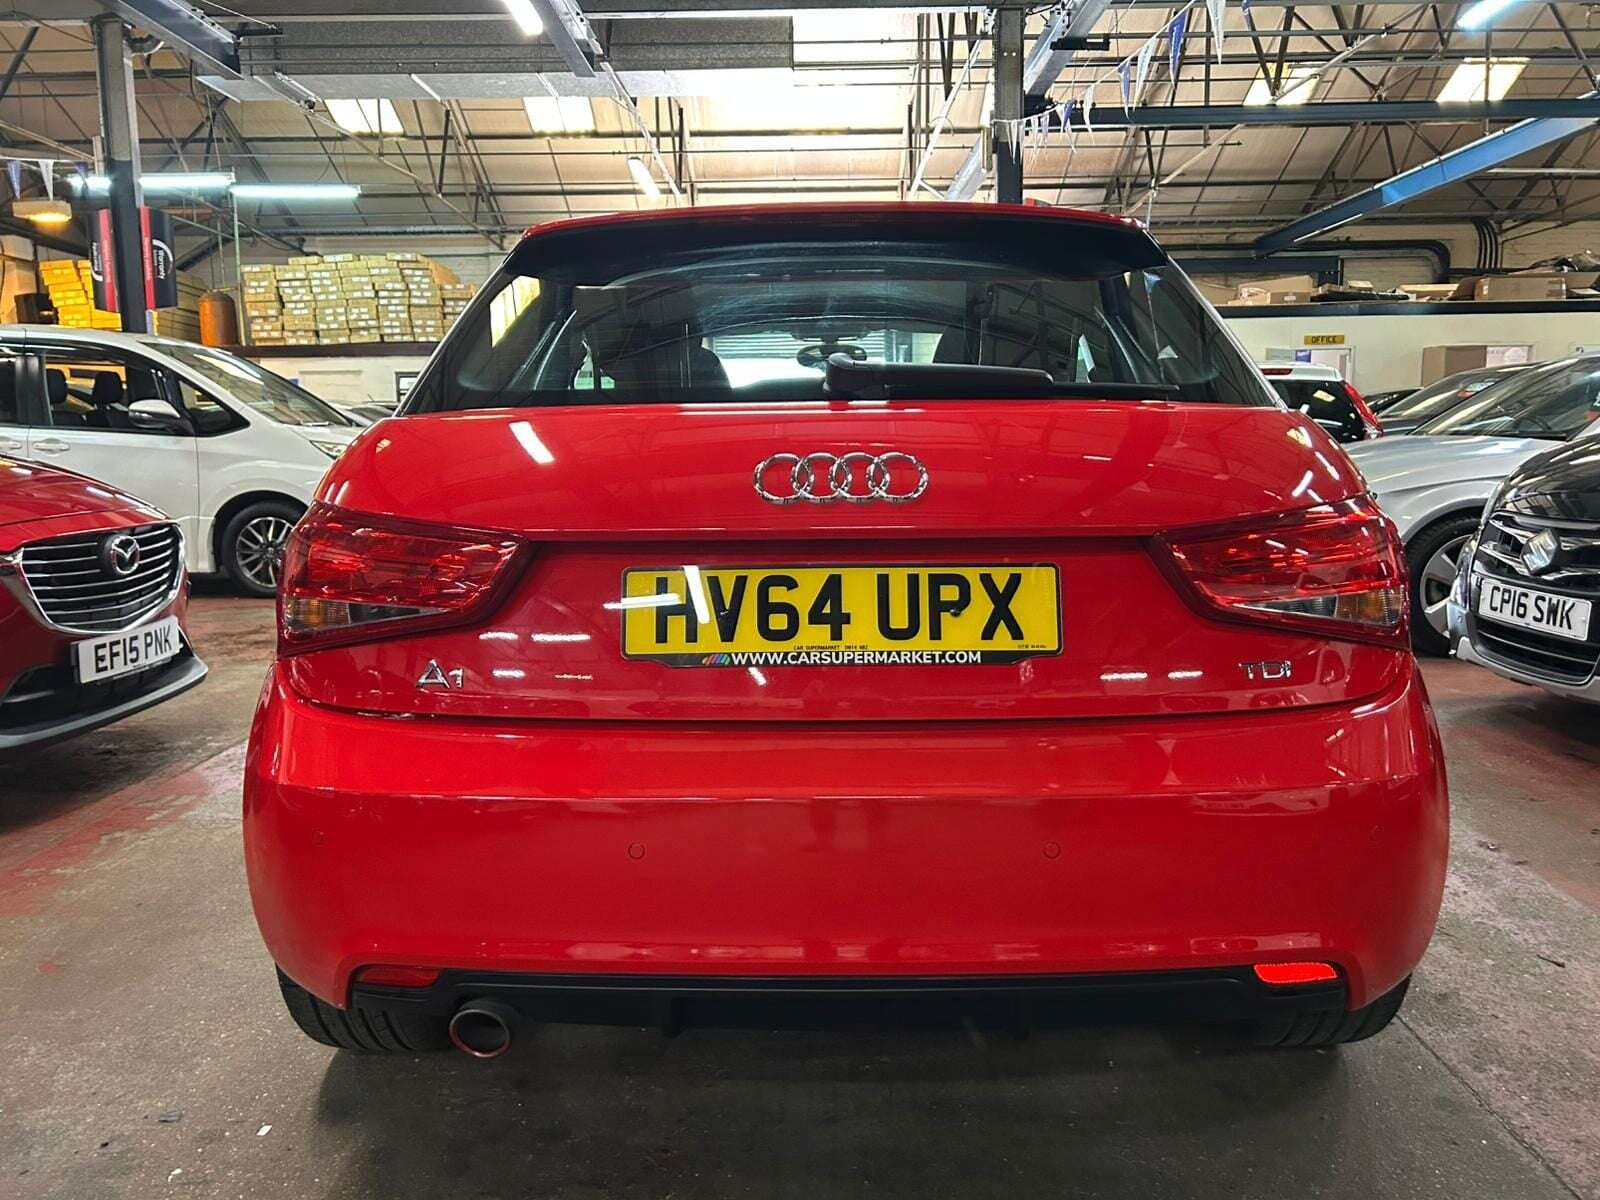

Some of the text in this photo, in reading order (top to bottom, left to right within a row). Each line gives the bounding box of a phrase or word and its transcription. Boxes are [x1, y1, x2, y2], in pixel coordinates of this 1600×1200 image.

[157, 250, 166, 279] Warranty
[655, 573, 1024, 644] HV64 UPX
[1489, 586, 1575, 630] CP16 SWK
[94, 624, 172, 673] EF15 PNK
[731, 651, 981, 665] WWW.CARSUPERMARKET.COM
[416, 659, 463, 688] A1
